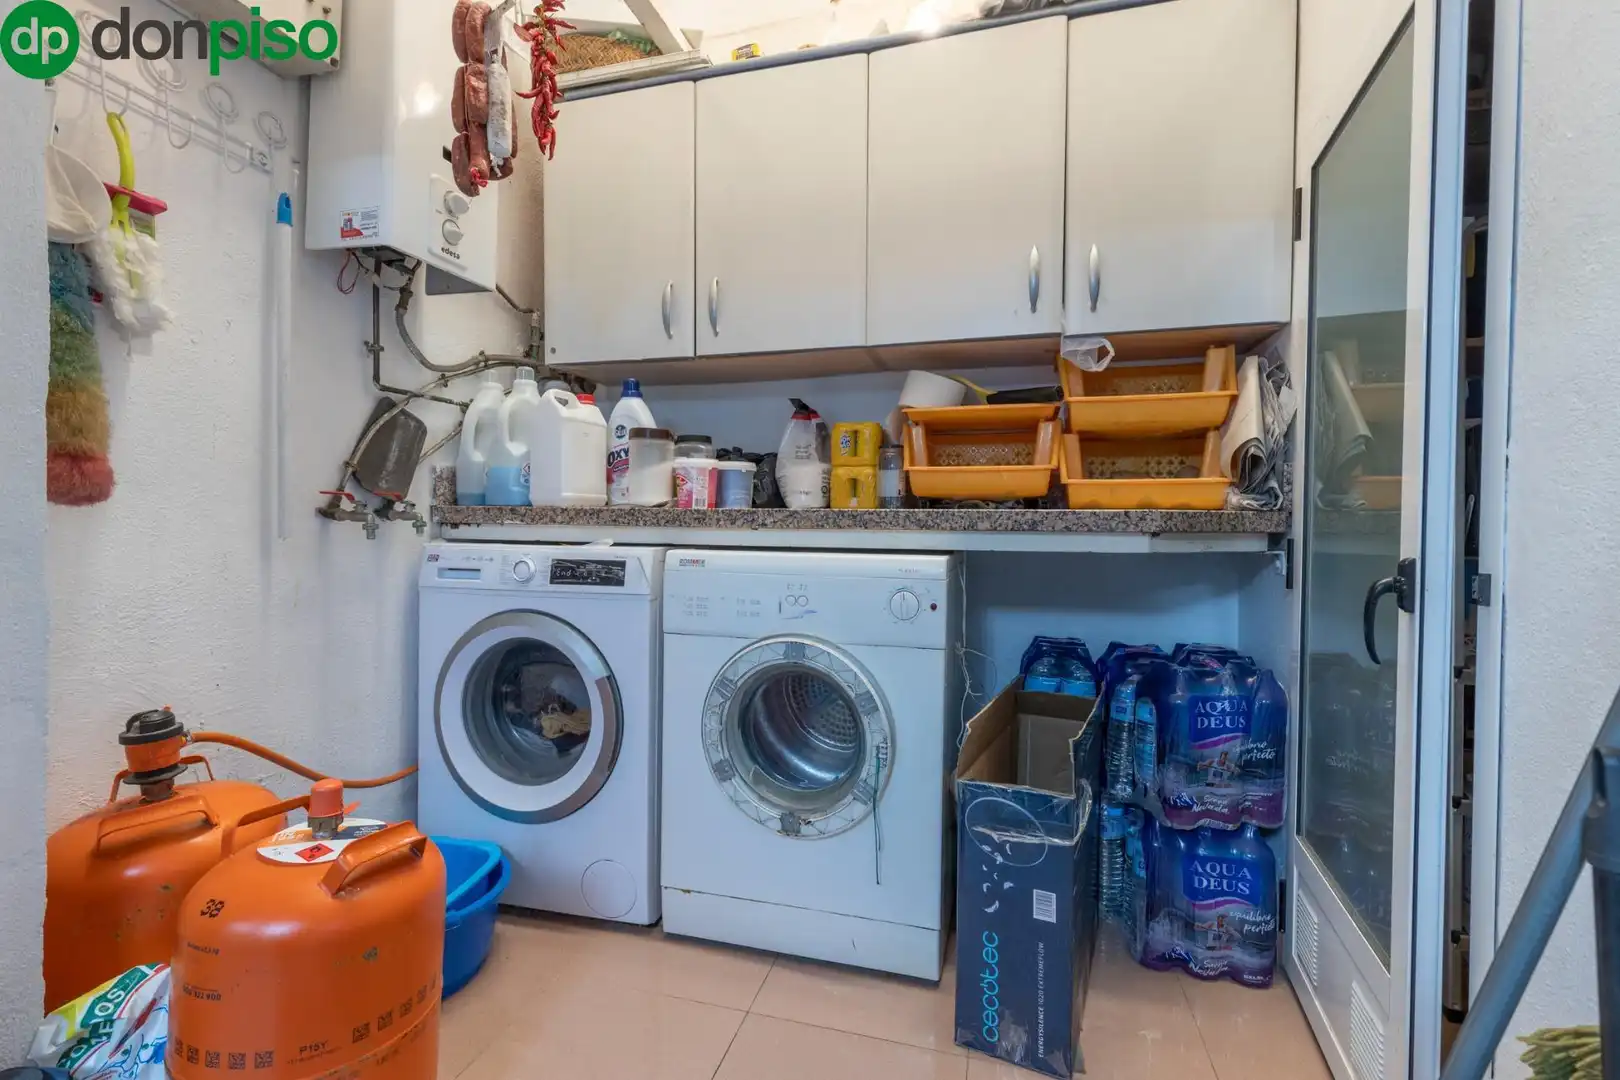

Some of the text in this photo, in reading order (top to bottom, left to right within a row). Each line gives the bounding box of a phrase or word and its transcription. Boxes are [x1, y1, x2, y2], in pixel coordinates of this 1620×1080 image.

[1195, 699, 1249, 715] AQUA
[1196, 715, 1247, 729] DEUS
[1189, 860, 1253, 881] AQUA
[1193, 875, 1250, 895] DEUS
[979, 930, 1000, 1043] cecotec
